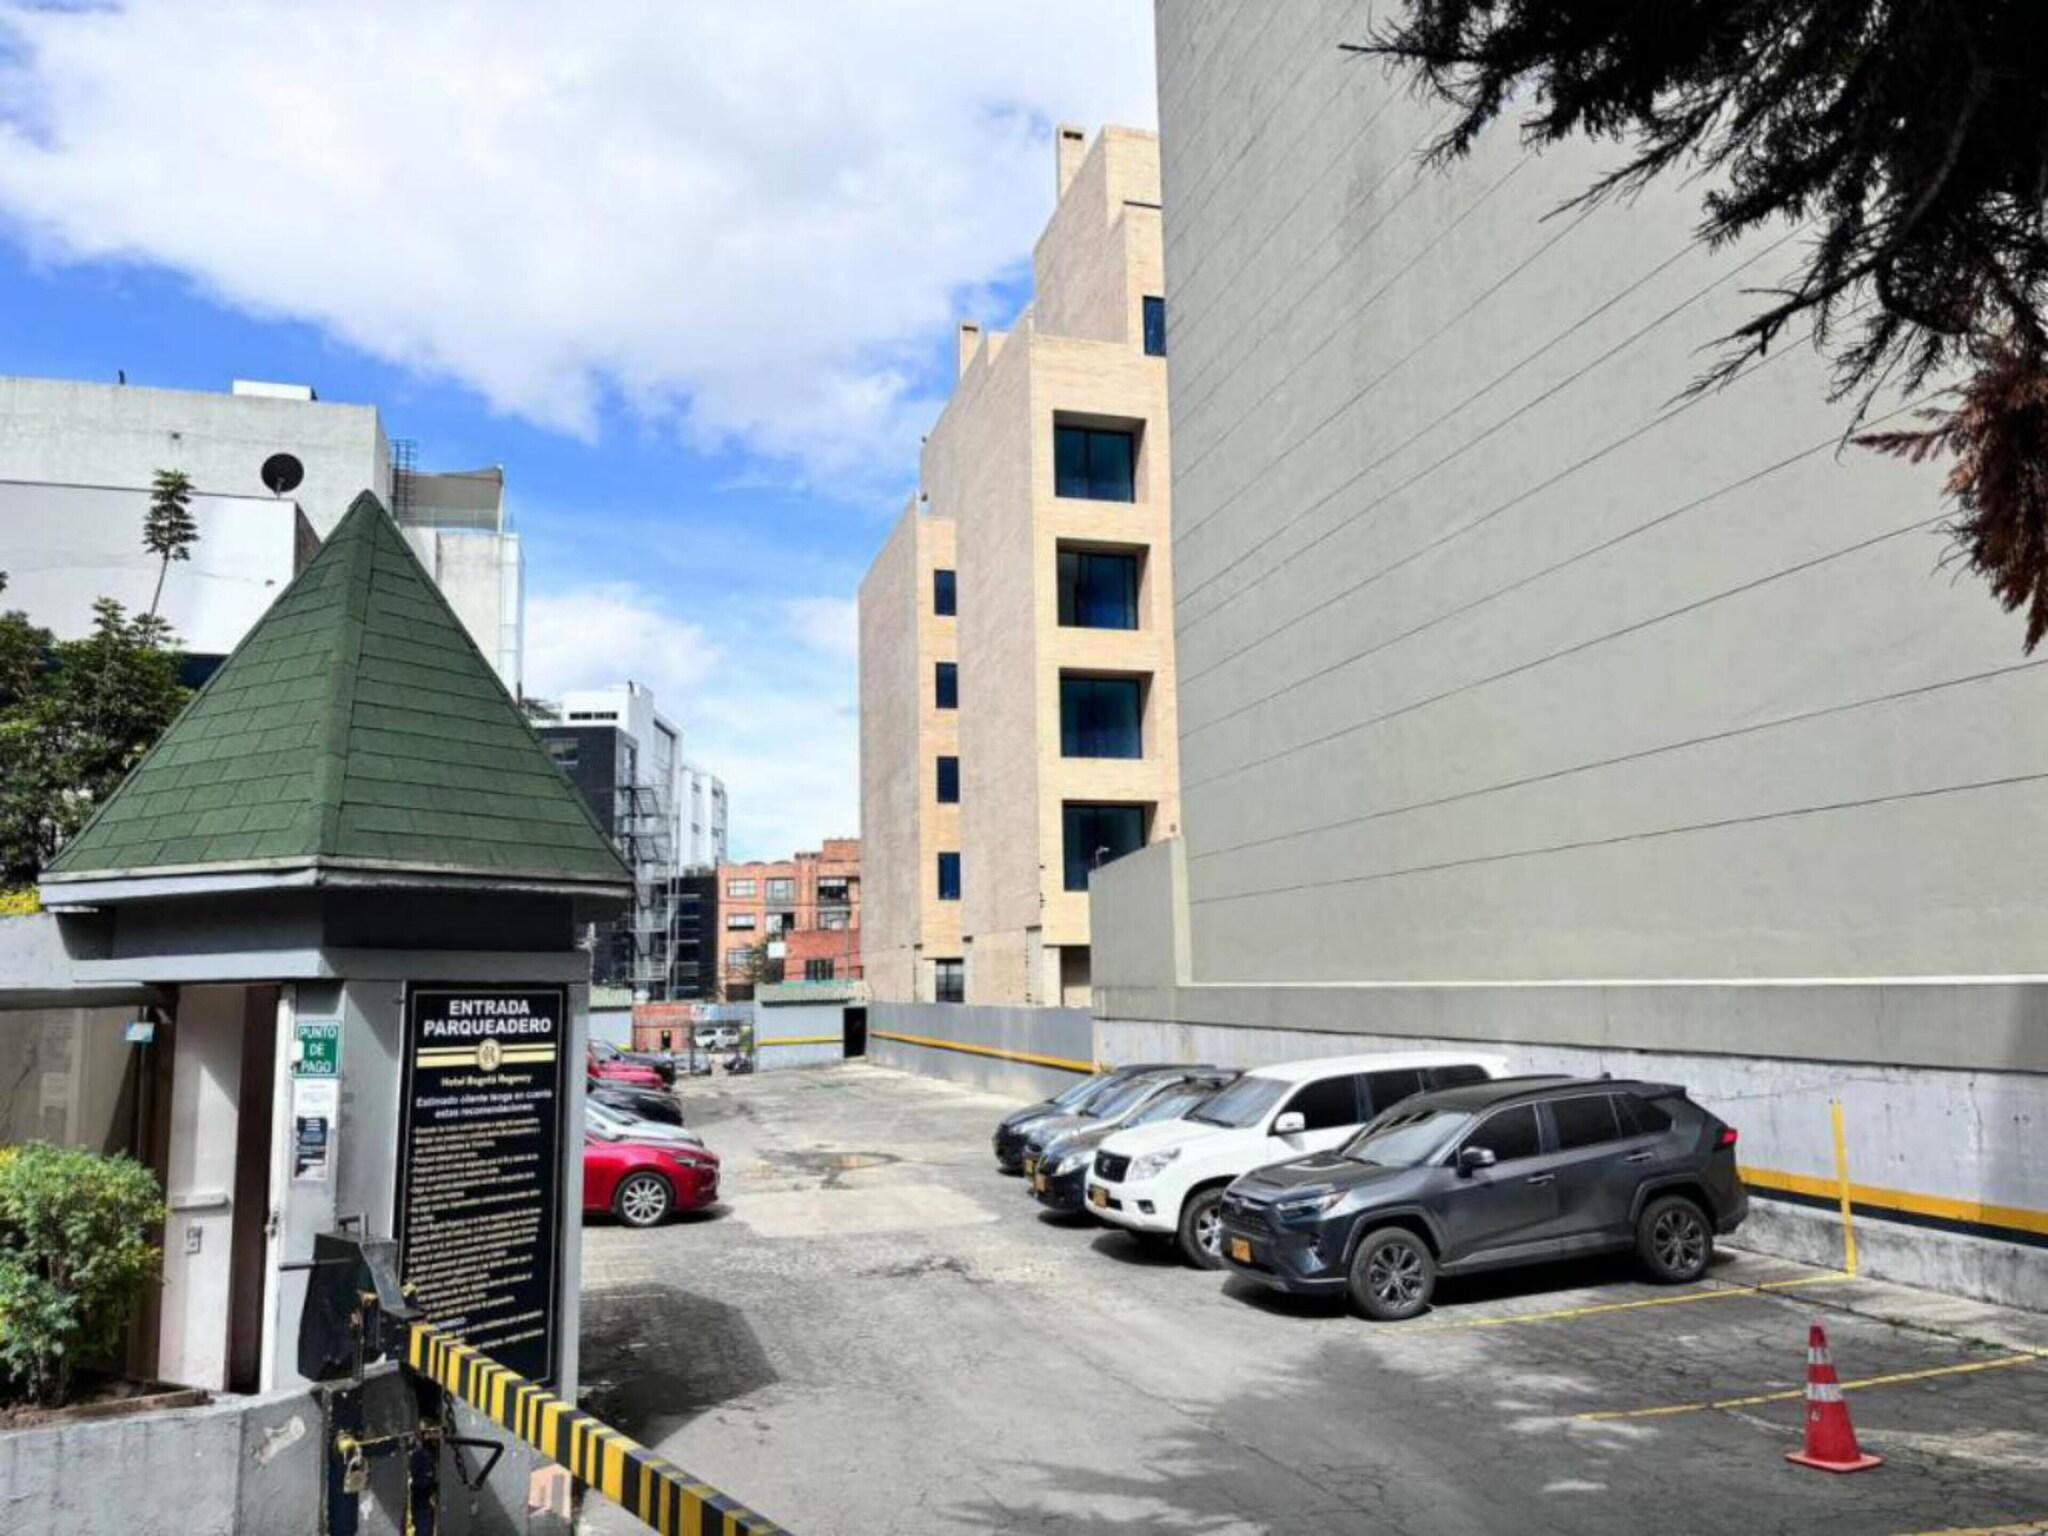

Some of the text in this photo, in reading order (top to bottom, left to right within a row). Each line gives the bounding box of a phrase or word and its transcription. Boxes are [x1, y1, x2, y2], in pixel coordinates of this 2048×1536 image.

[449, 1000, 530, 1016] ENTRADA
[299, 1027, 337, 1039] PUNTO
[423, 1018, 552, 1036] PARQUEADERO
[309, 1043, 325, 1056] DE
[301, 1061, 332, 1073] PAGO
